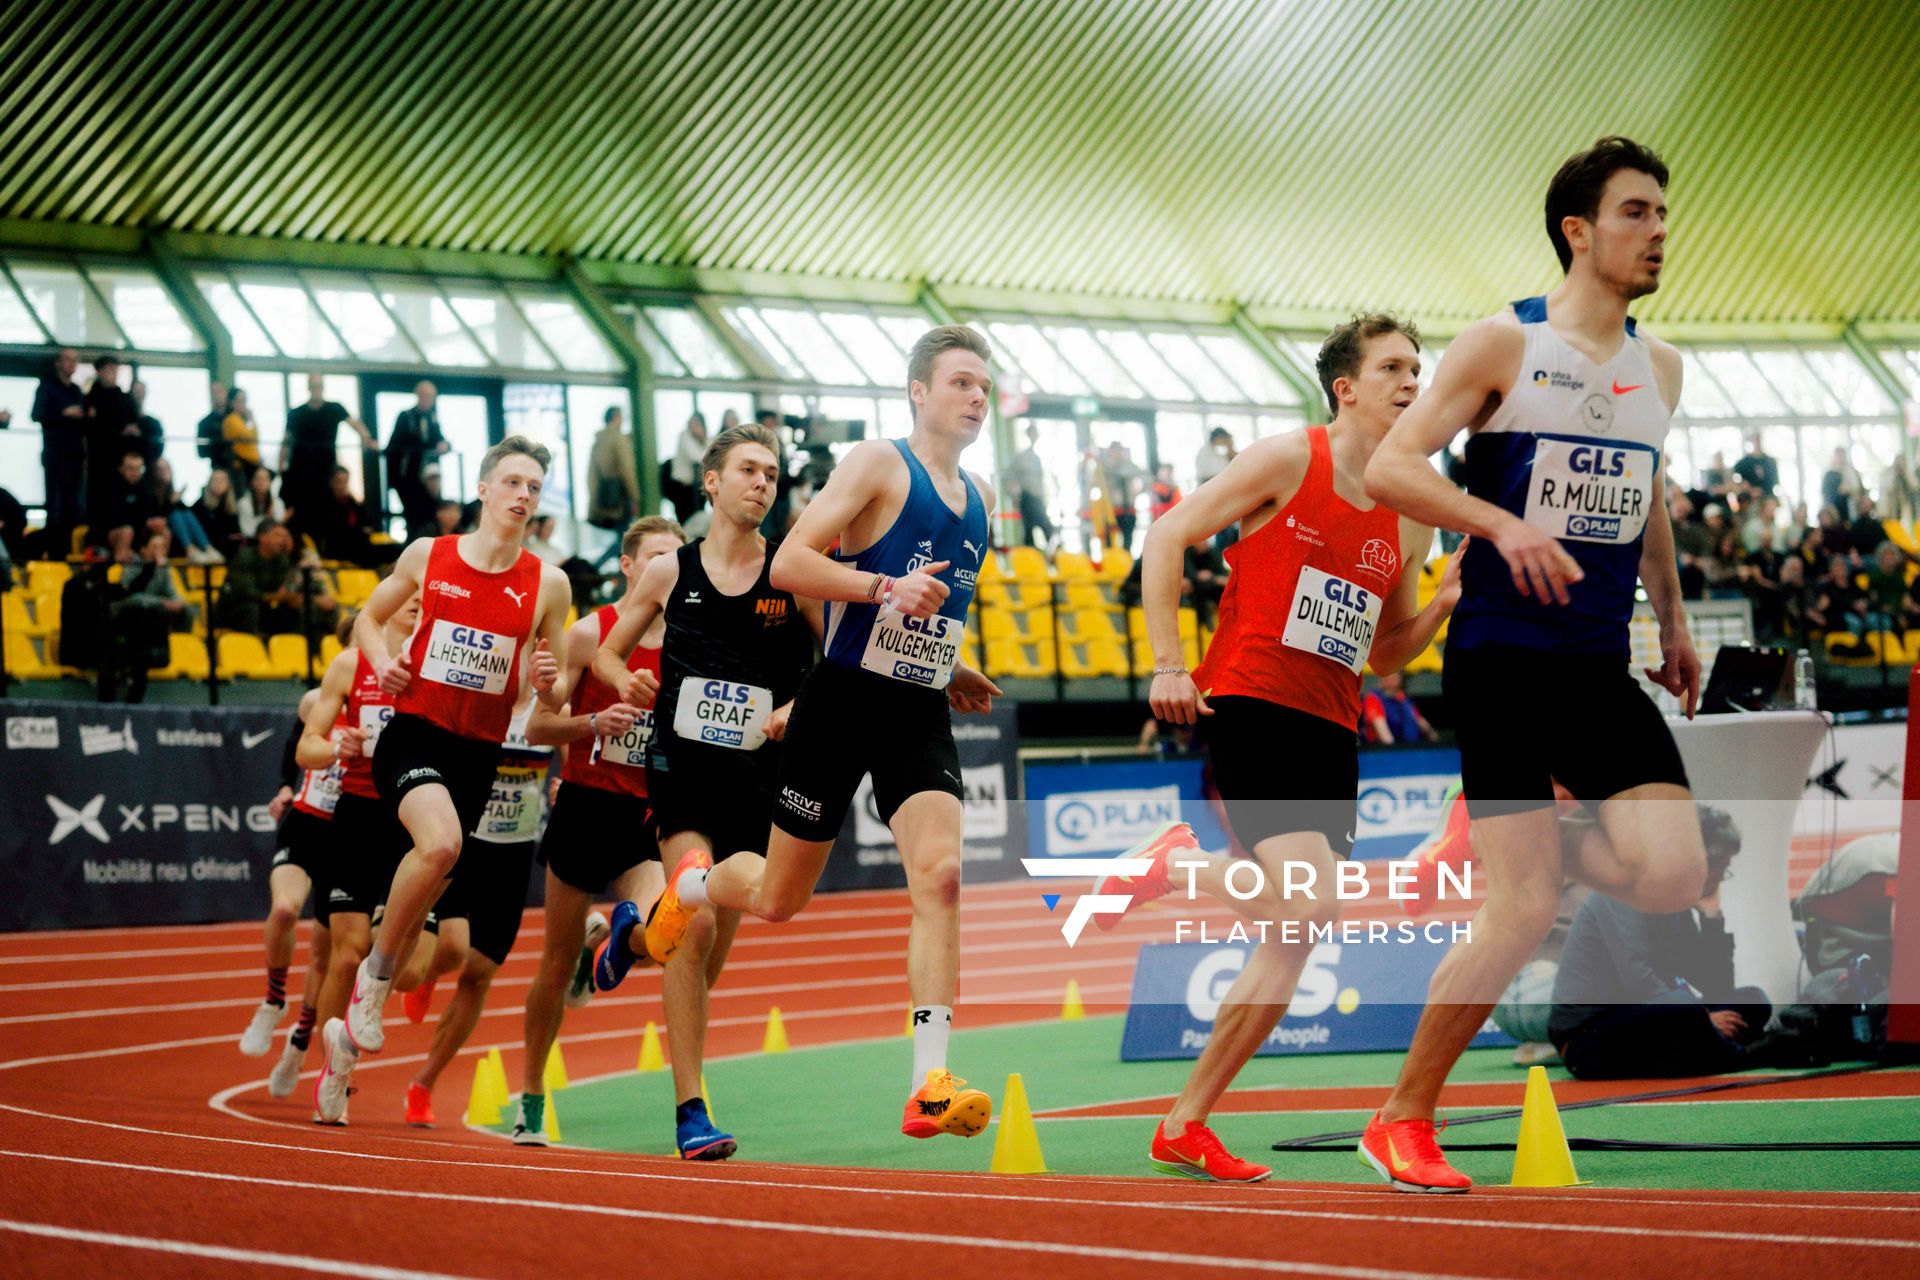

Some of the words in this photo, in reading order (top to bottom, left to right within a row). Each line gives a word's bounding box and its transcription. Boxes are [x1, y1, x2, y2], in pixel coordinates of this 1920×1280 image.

[1540, 476, 1643, 517] R.MÜLLER
[1297, 522, 1320, 536] Taunus
[1590, 520, 1619, 532] PLAN
[755, 598, 786, 615] Nill
[1297, 595, 1374, 650] DILLEMUTH
[875, 626, 956, 666] KULGEMEYER
[1336, 645, 1357, 659] PLAN
[429, 640, 510, 675] L.HEYMANN
[461, 674, 485, 684] PLAN
[911, 668, 934, 680] PLAN
[696, 700, 755, 727] GRAF
[609, 727, 650, 749] RÖH
[718, 730, 742, 742] PLAN
[1405, 786, 1449, 810] PL
[118, 803, 277, 832] XPENG
[1103, 802, 1173, 825] PLAN
[1267, 1024, 1331, 1046] People
